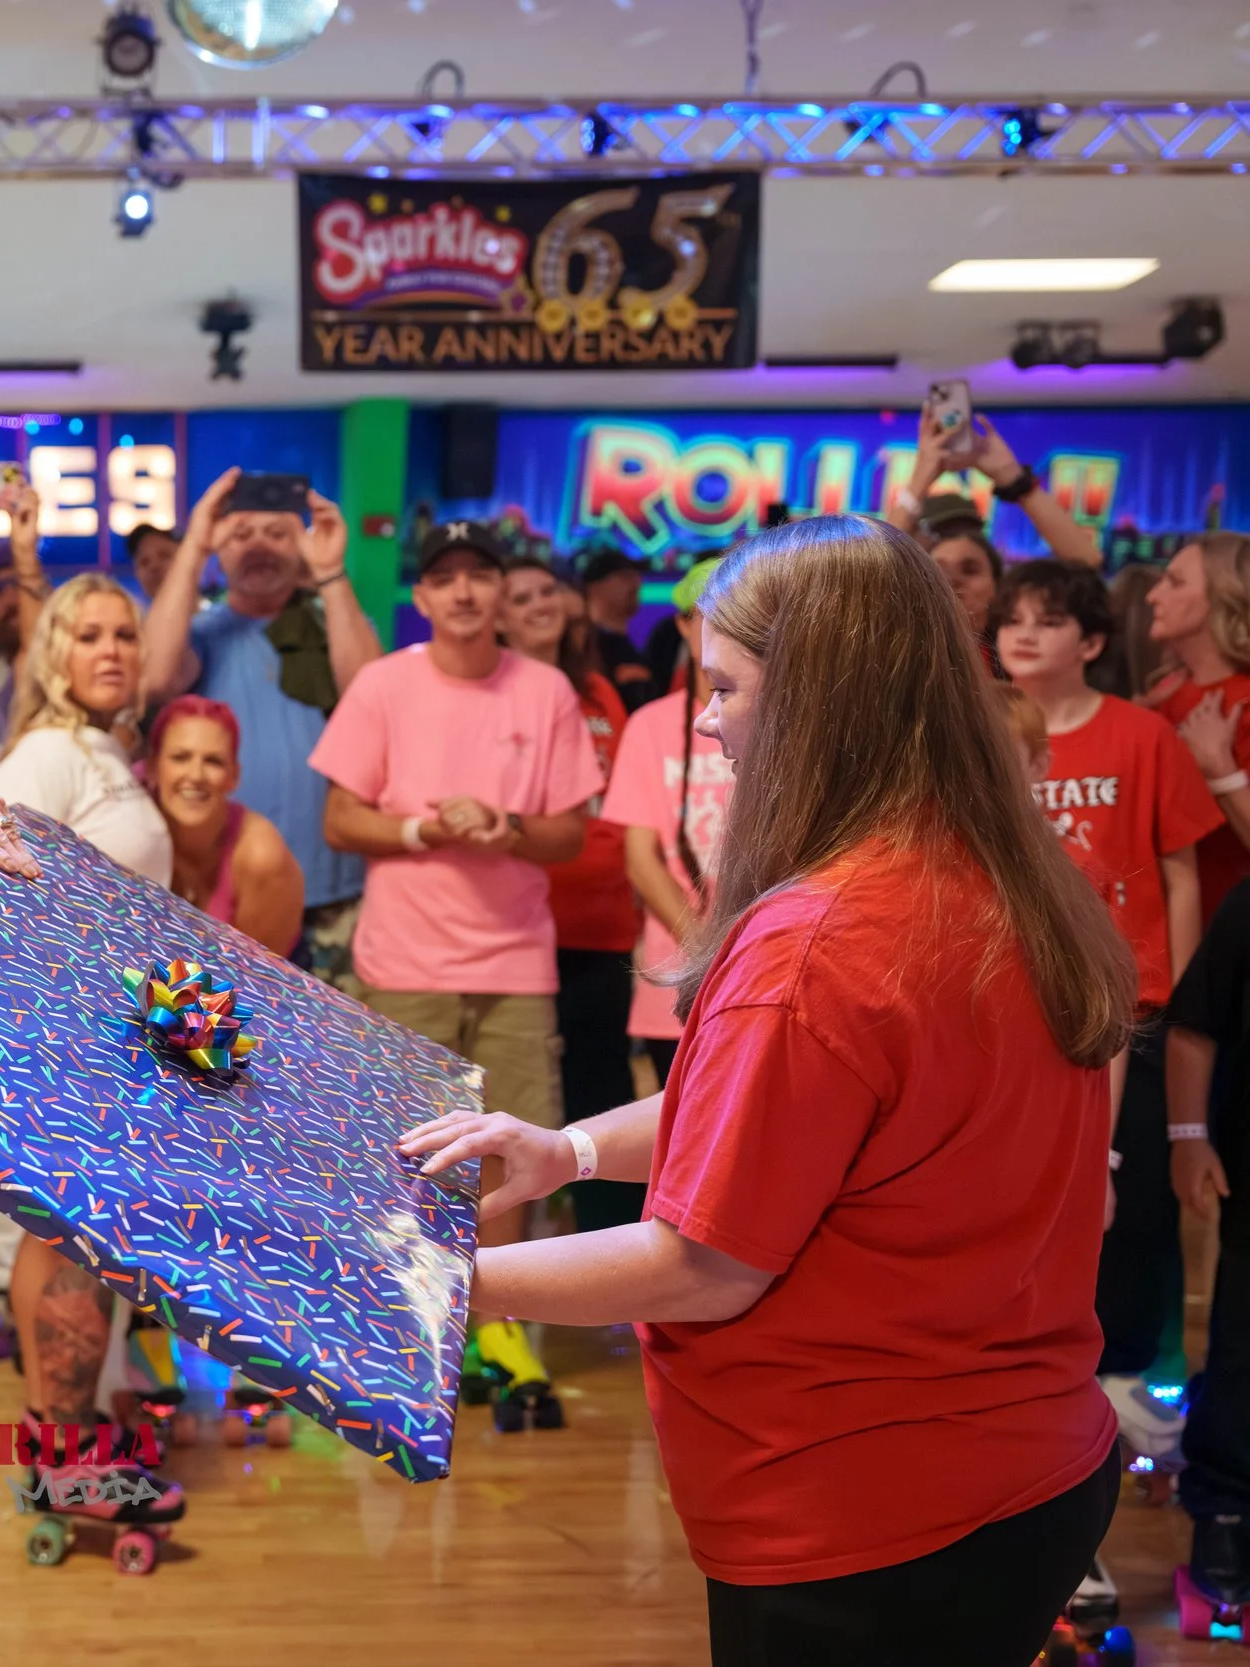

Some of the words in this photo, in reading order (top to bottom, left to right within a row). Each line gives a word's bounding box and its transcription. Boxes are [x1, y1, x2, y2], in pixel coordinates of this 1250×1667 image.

[317, 206, 524, 295] Sparkles
[533, 184, 736, 306] 65
[314, 325, 425, 364] YEAR
[432, 321, 736, 363] ANNIVERSARY
